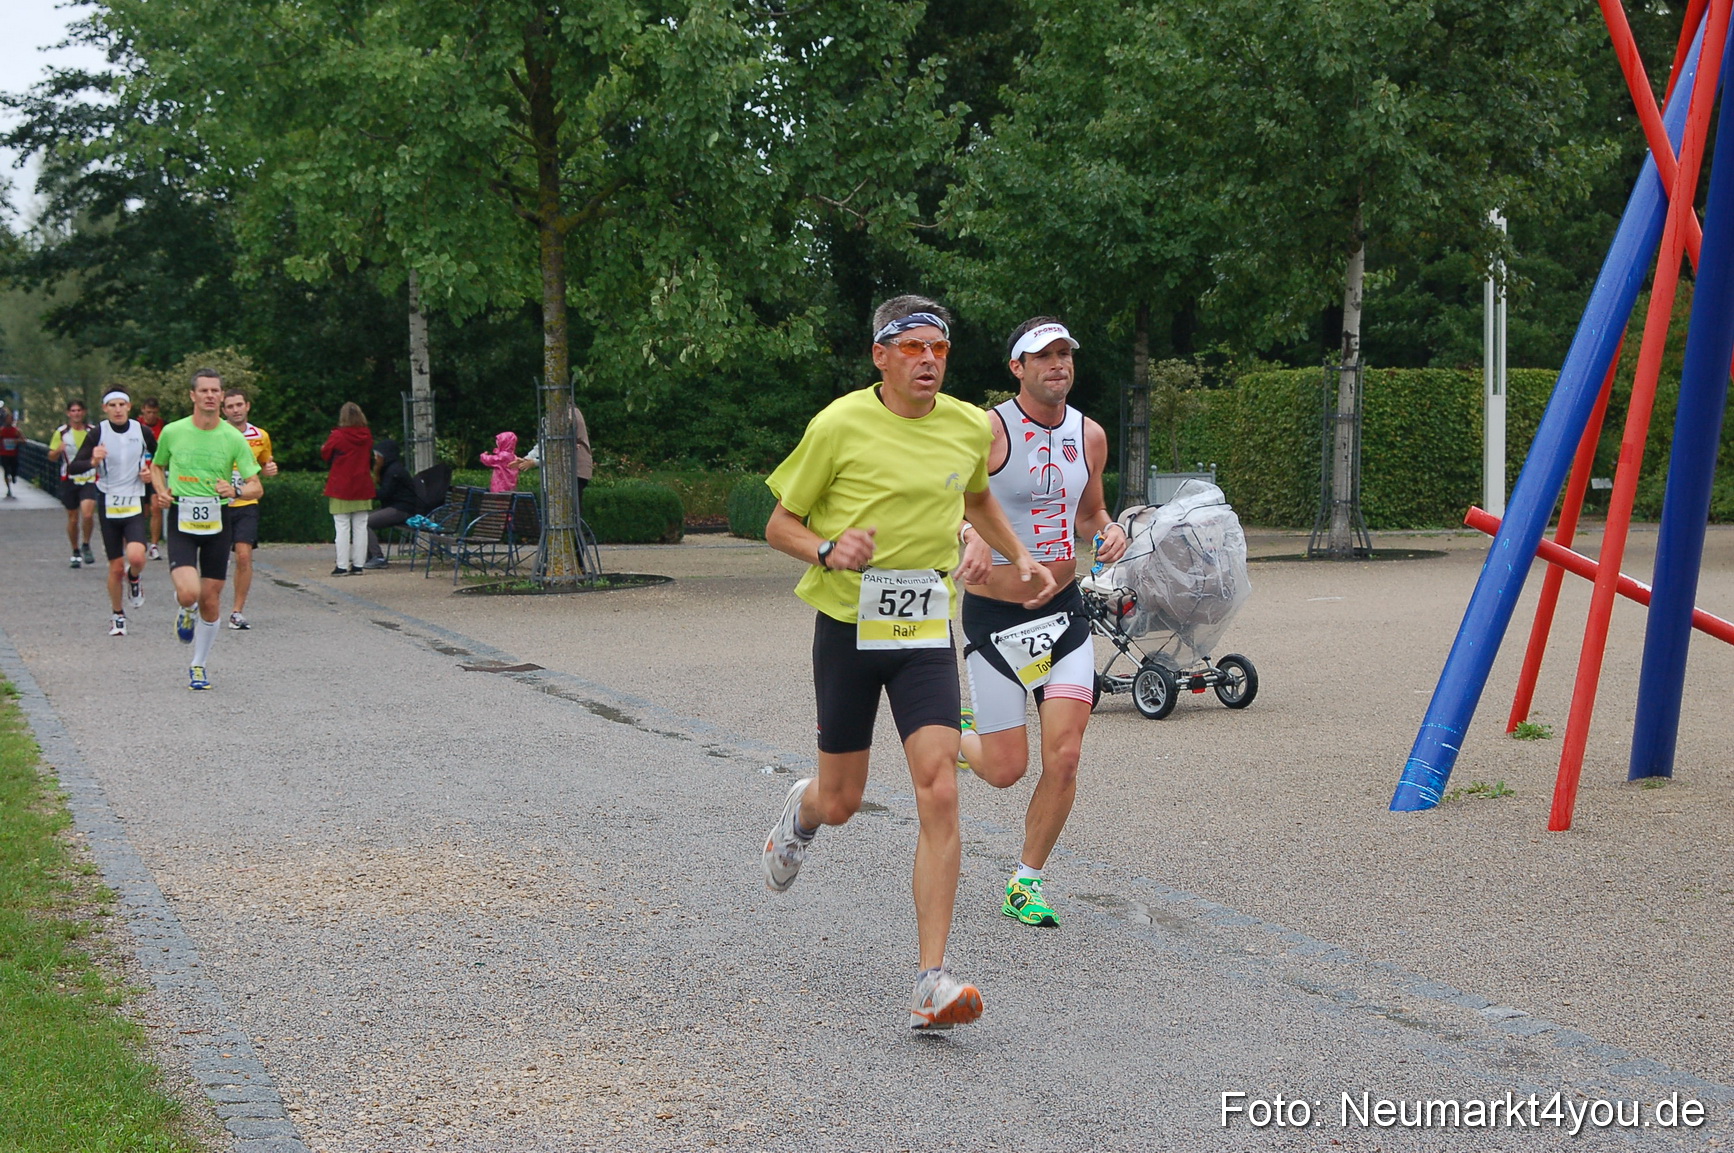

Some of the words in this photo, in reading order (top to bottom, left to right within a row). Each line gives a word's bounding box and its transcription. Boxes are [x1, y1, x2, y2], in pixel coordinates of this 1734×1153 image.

[192, 506, 209, 520] 83
[863, 573, 895, 585] PARTL
[878, 588, 932, 617] 521
[1022, 633, 1054, 658] 23
[1035, 657, 1052, 673] Tob
